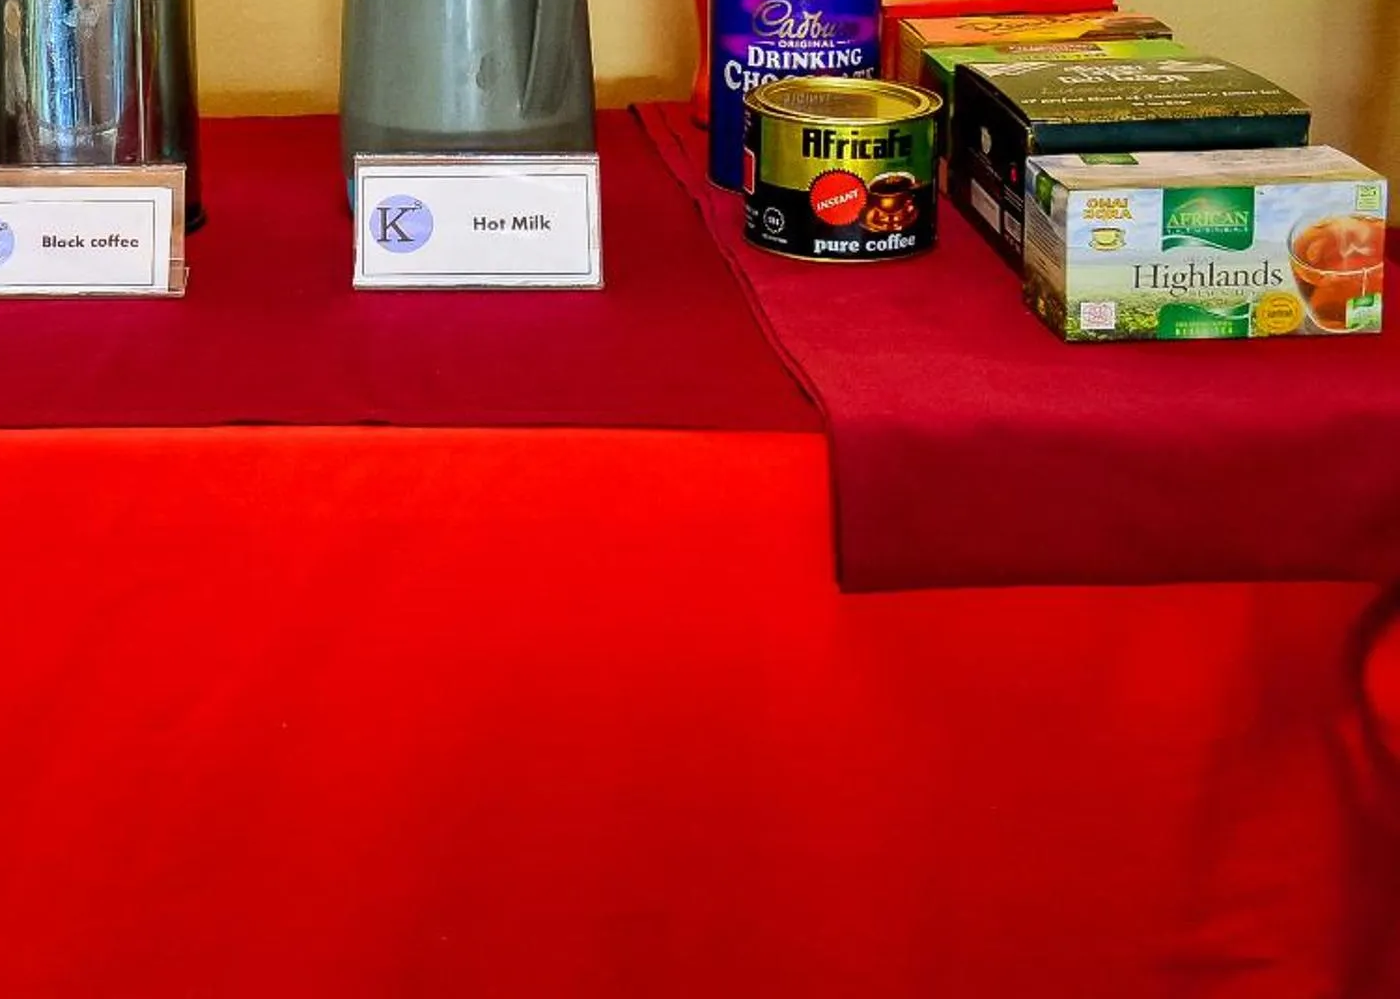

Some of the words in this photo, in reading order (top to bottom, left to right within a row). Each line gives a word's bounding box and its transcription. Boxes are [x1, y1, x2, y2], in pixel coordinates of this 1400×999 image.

[777, 40, 835, 49] ORIGINAL
[747, 45, 863, 70] DRINKING
[724, 59, 875, 93] CHOTE
[802, 128, 913, 159] Africafe
[816, 187, 860, 211] INSTANT
[472, 216, 506, 231] Hot
[511, 215, 551, 231] Milk
[1167, 210, 1250, 227] AFRICAN
[90, 234, 140, 248] coffee
[813, 238, 860, 254] pure
[865, 234, 916, 252] coffee
[1132, 260, 1284, 297] Highlands
